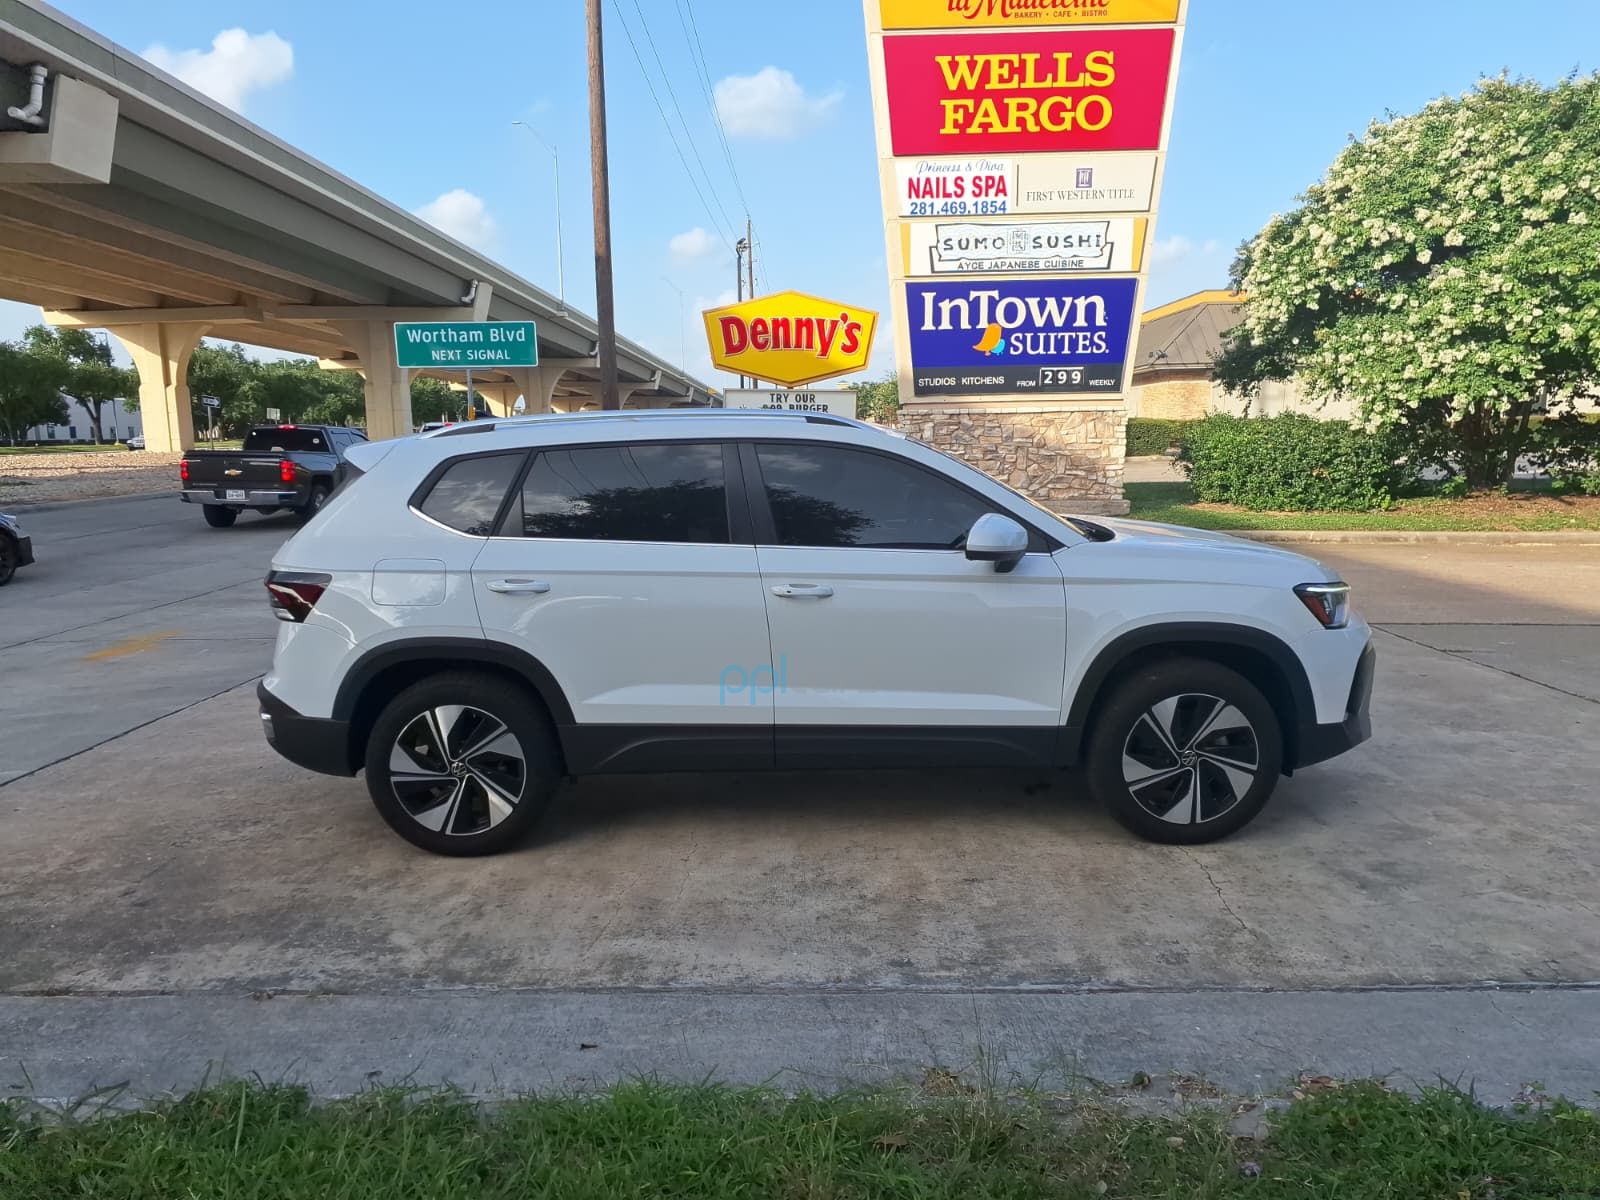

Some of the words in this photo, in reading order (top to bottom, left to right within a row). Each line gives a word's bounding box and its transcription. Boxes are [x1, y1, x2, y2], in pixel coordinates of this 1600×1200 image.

[1081, 9, 1108, 17] BISTRO
[935, 50, 1116, 91] WELLS
[939, 94, 1114, 135] FARGO
[916, 160, 961, 174] Princess
[965, 162, 972, 172] &
[975, 159, 1005, 172] Diva
[908, 176, 965, 199] NAILS
[971, 175, 1007, 198] SPA
[1026, 191, 1054, 201] FIRST
[1057, 189, 1105, 201] WESTERN
[1107, 188, 1135, 199] TITLE
[910, 200, 1007, 215] 281.469.1854
[943, 237, 1005, 251] SUMO
[1032, 234, 1102, 249] SUSHI
[958, 262, 985, 270] AYCE
[988, 260, 1040, 270] JAPANESE
[1044, 259, 1084, 269] CUISINE
[920, 290, 1107, 331] InTown
[406, 328, 483, 343] Wortham
[490, 327, 526, 342] Blvd
[719, 312, 862, 358] Denny's
[432, 350, 462, 361] NEXT
[467, 349, 511, 360] SIGNAL
[918, 378, 956, 387] STUDIOS
[962, 376, 1005, 386] KITCHENS
[1016, 380, 1036, 388] FROM
[1089, 379, 1116, 387] WEEKLY
[769, 393, 789, 403] TRY
[795, 393, 816, 403] OUR
